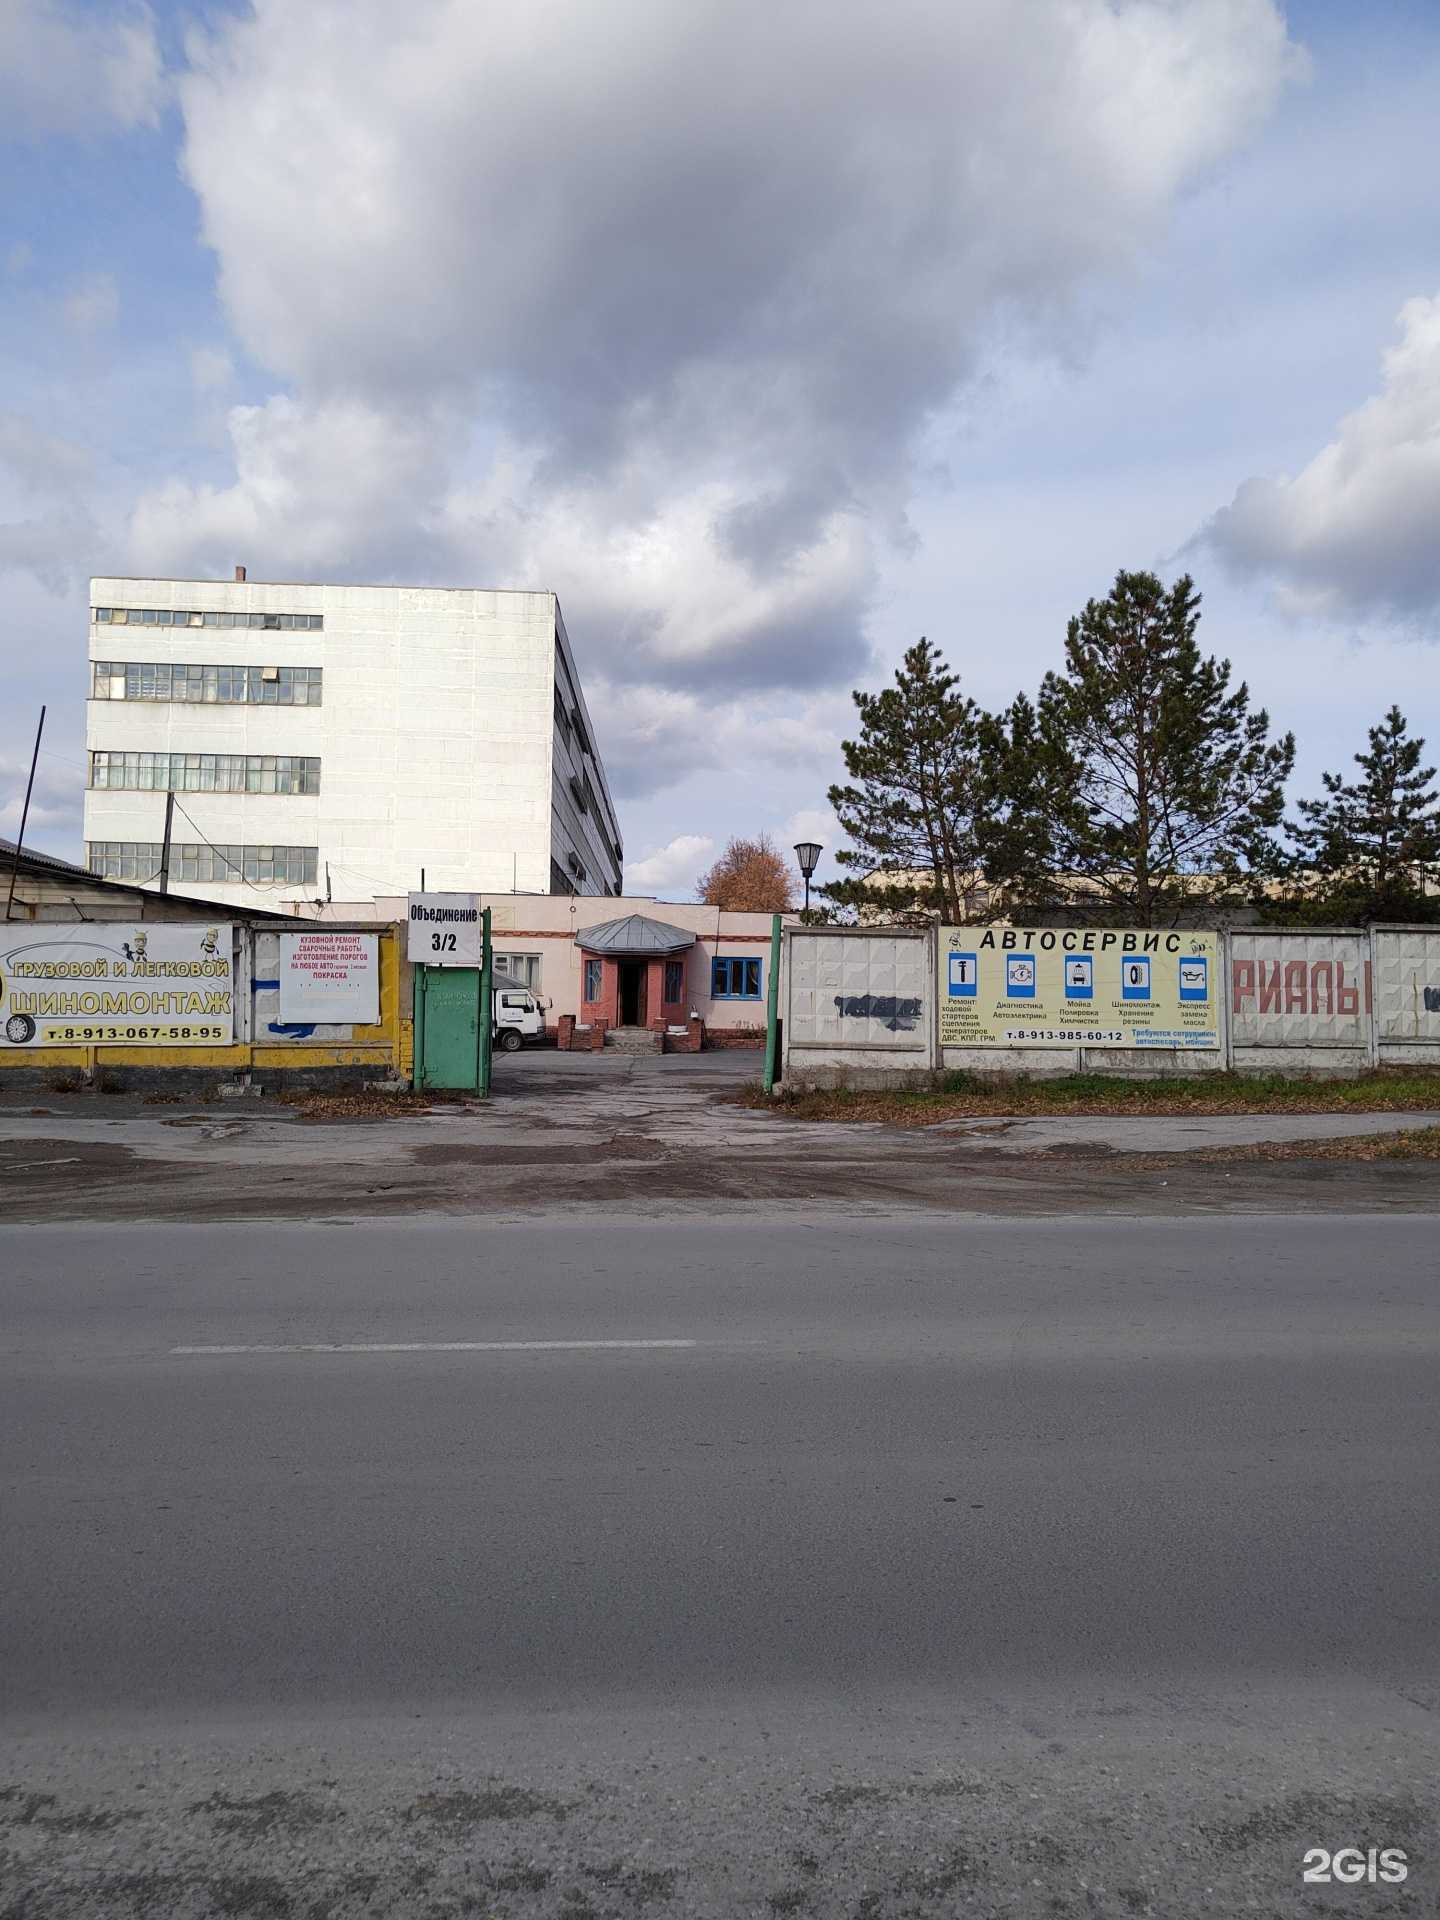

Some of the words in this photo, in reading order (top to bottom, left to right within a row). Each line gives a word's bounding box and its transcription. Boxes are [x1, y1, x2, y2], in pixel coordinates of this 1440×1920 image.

[411, 905, 478, 923] Объединение
[300, 936, 334, 944] КУЗОВНОЙ
[335, 936, 361, 944] РЕМОНТ
[432, 933, 457, 951] 3/2
[979, 931, 1181, 952] АВТОСЕРВИС
[14, 959, 108, 977] ГРУЗОВОЙ
[114, 963, 127, 977] И
[131, 959, 229, 977] ЛЕГКОВОЙ
[10, 992, 231, 1015] ШИНОМОНТАЖ
[993, 1012, 1047, 1020] Автоэлектрика
[1059, 1009, 1099, 1017] Полировка
[48, 1027, 222, 1039] т.8-913-067-58-95
[1007, 1031, 1122, 1041] т.8-913-985-60-12
[1132, 1029, 1171, 1037] Требуются
